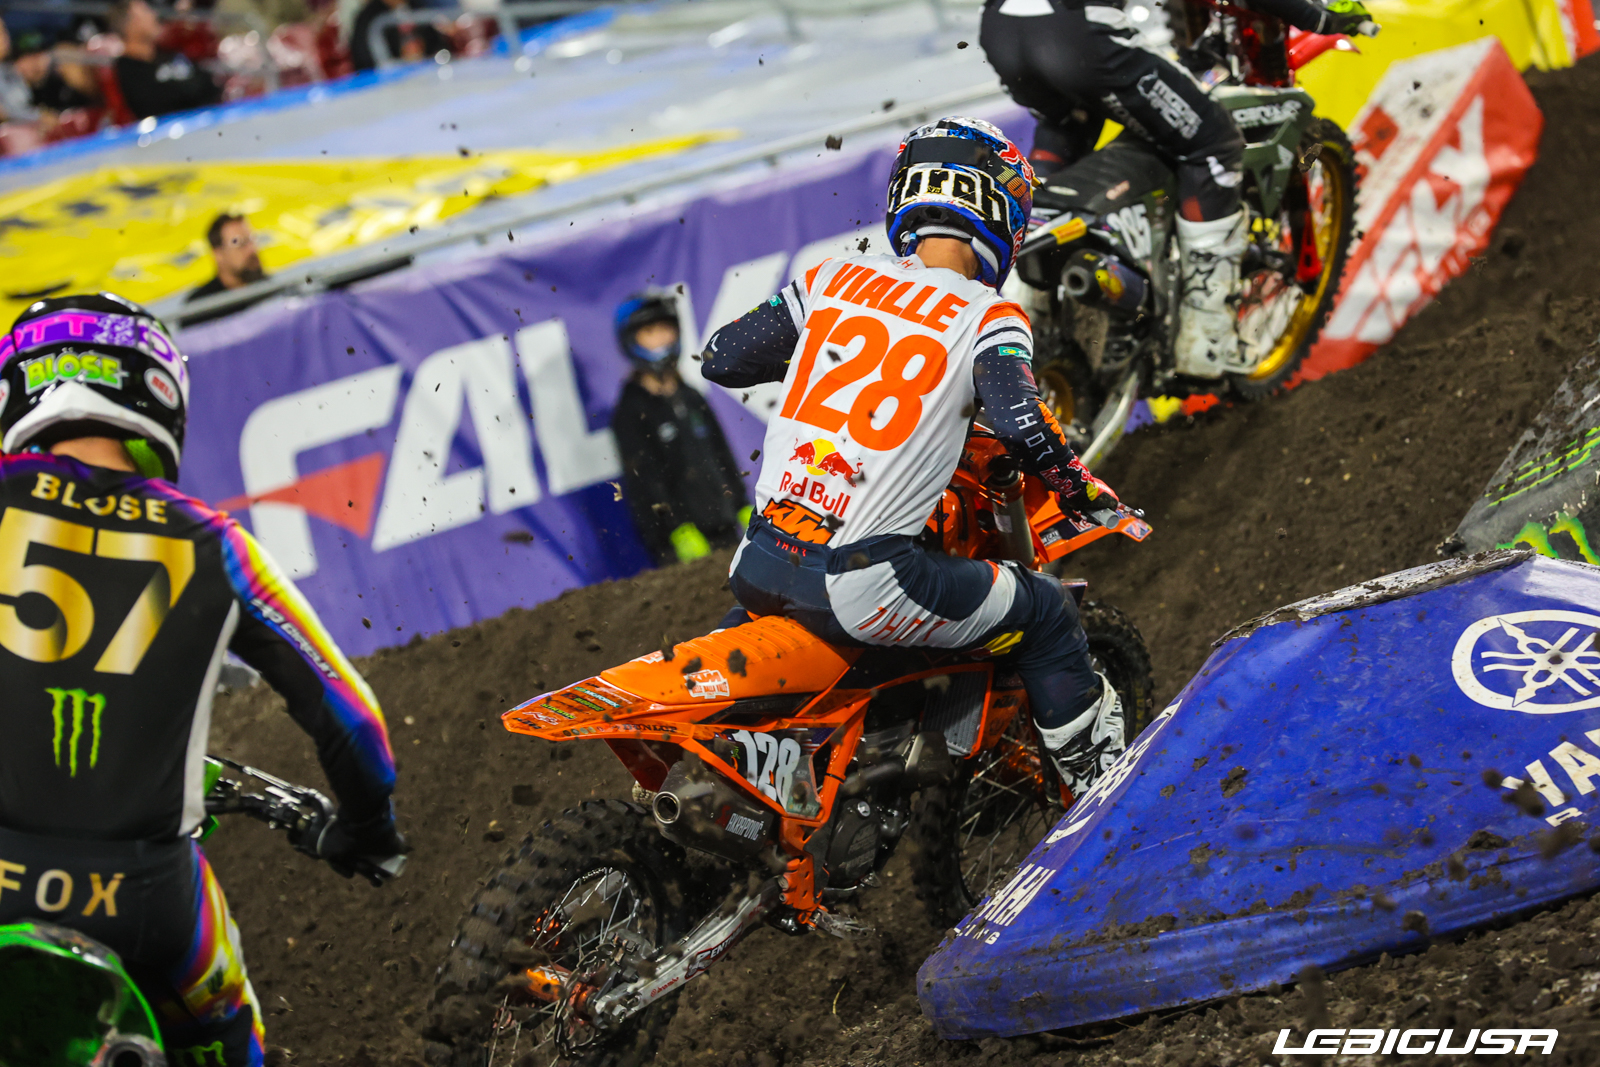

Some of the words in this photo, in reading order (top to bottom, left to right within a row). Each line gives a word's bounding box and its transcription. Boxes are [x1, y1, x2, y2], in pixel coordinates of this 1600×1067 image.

[822, 263, 970, 333] VIALLE
[26, 353, 119, 390] BLOSE
[779, 306, 948, 452] 128
[31, 472, 169, 525] BLOSE
[761, 497, 837, 546] KTM
[808, 480, 852, 518] Bull
[0, 506, 196, 675] 57
[622, 722, 678, 733] DUNLOP
[732, 728, 801, 812] 128
[0, 859, 125, 918] FOX
